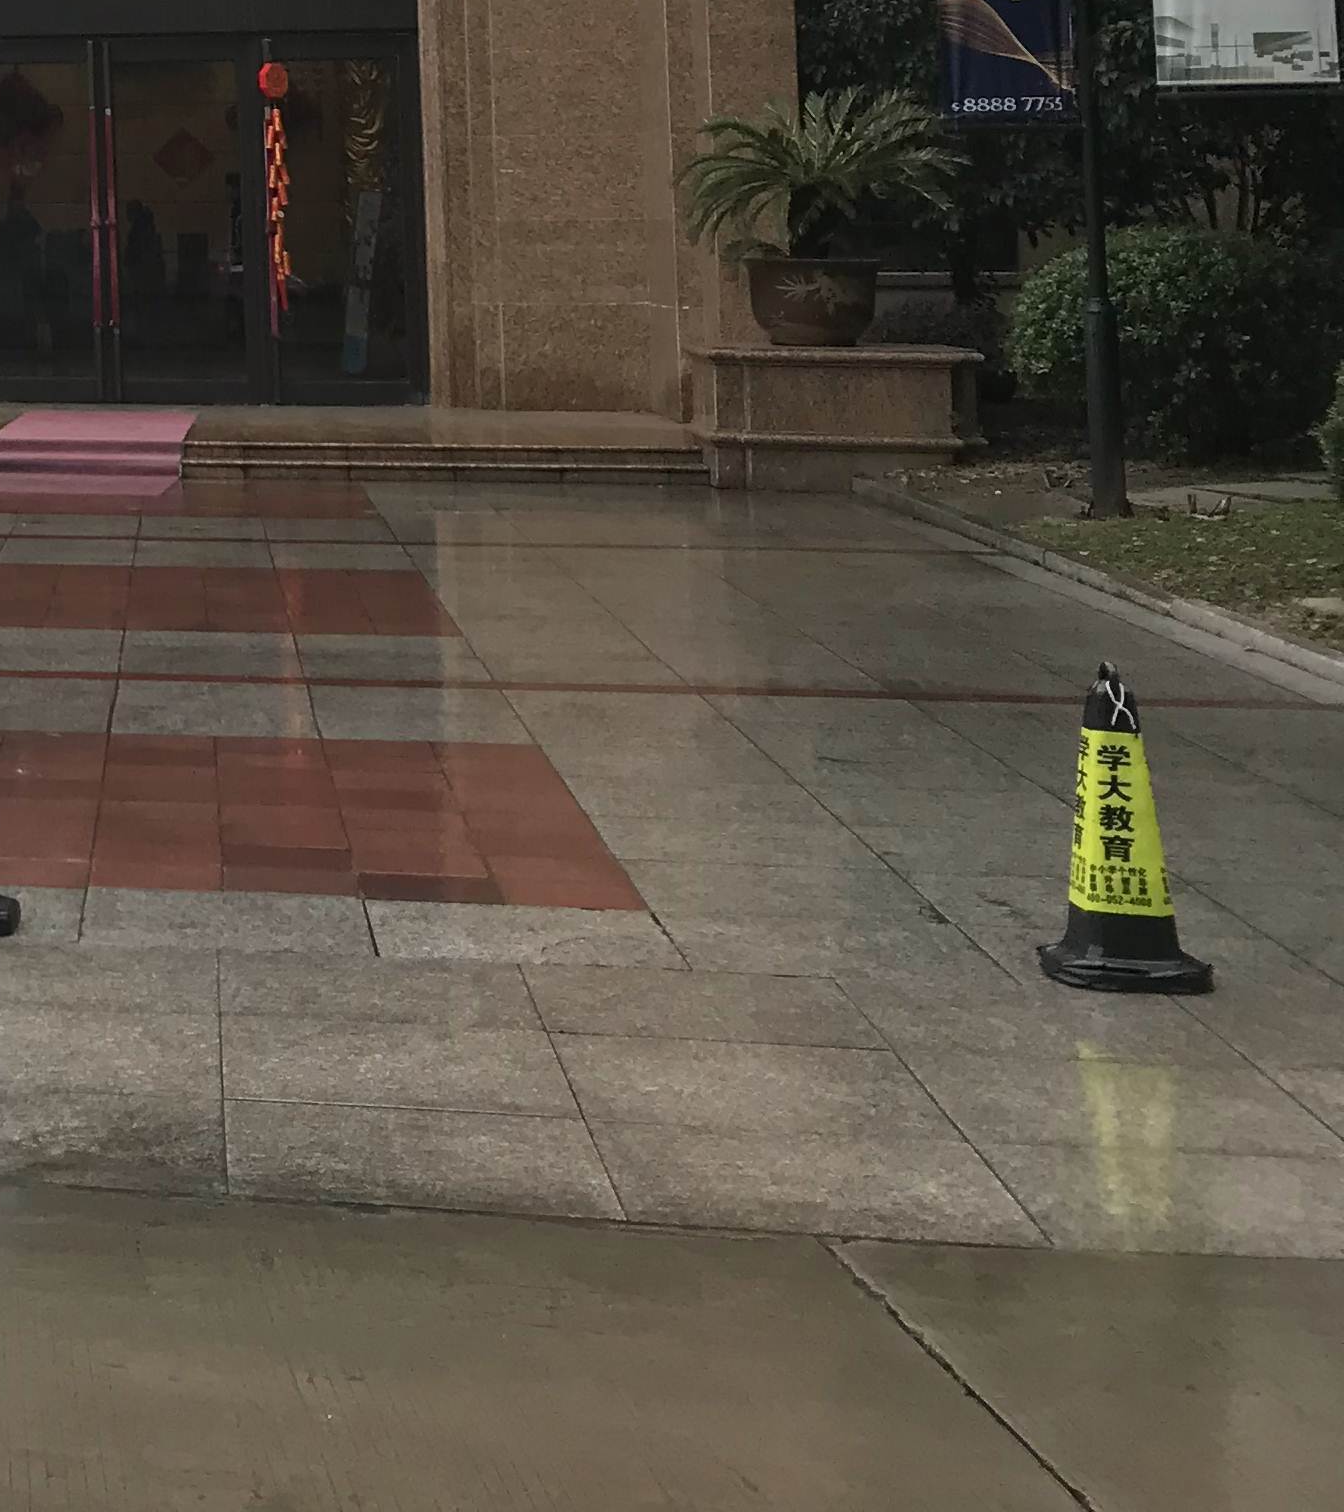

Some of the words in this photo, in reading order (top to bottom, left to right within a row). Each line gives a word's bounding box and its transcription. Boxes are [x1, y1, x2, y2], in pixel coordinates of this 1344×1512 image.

[962, 97, 1017, 112] 8888
[1020, 96, 1063, 111] 7755
[1096, 744, 1135, 862] 学大教育
